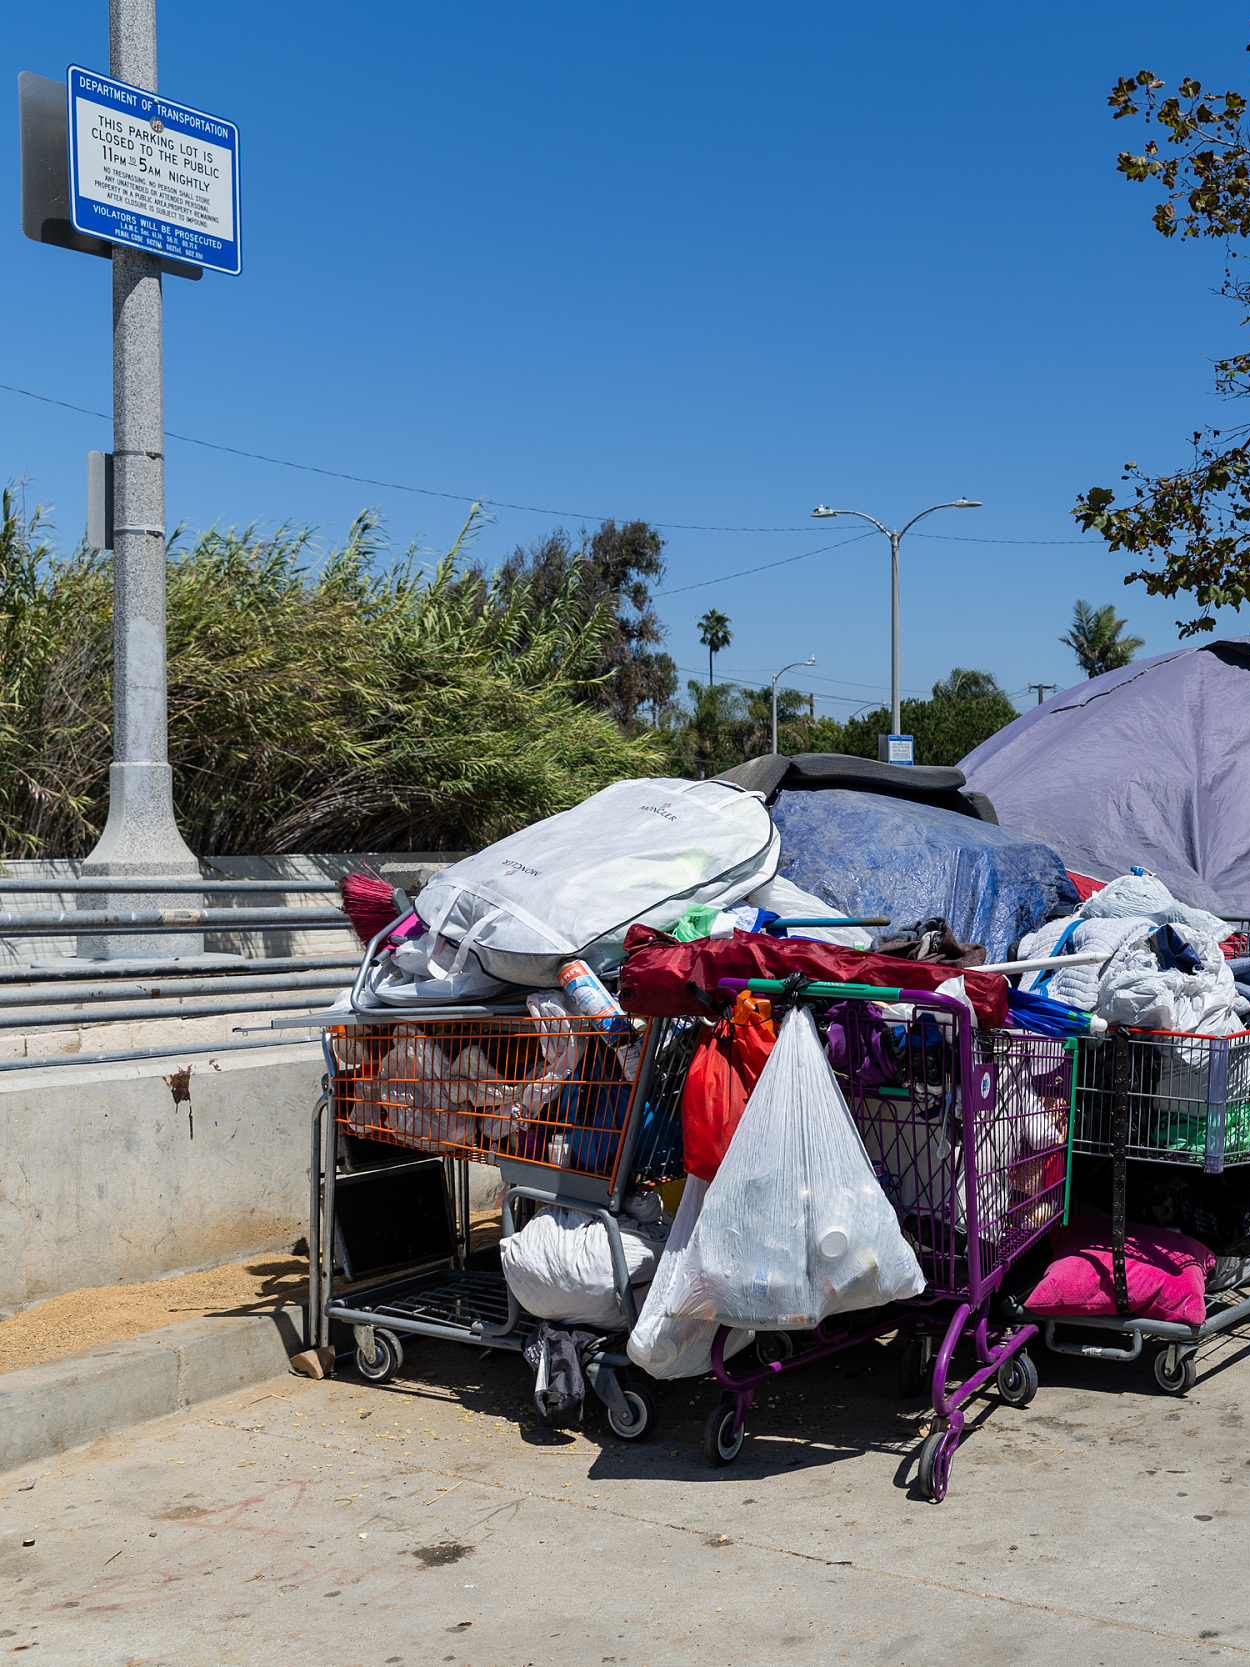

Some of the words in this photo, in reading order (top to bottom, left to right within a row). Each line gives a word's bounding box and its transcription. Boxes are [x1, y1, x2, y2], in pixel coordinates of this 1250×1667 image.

[80, 76, 137, 106] DEPARTMENT
[141, 99, 153, 111] OF
[157, 104, 228, 139] TRANSPORTATION
[91, 128, 134, 150] CLOSED
[140, 143, 153, 156] TO
[159, 150, 178, 165] THE
[184, 158, 219, 178] PUBLIC
[98, 115, 123, 133] THIS
[129, 126, 174, 150] PARKING
[180, 143, 198, 158] LOT
[204, 151, 213, 163] IS
[103, 166, 111, 174] NO
[158, 183, 177, 194] PERSON
[179, 190, 194, 200] SHALL
[195, 195, 210, 205] STORE
[129, 156, 137, 164] TO
[169, 170, 210, 192] NIGHTLY
[95, 180, 121, 193] PROPERTY
[135, 193, 152, 203] PUBLIC
[194, 211, 219, 223] REMAINING
[105, 175, 115, 183] ANY
[117, 179, 149, 194] UNATTENDED
[160, 192, 183, 204] ATTENDED
[185, 200, 209, 213] PERSONAL
[107, 192, 123, 202] AFTER
[125, 198, 147, 210] CLOSURE
[156, 207, 176, 219] SUBJECT
[93, 204, 137, 224] VIOLATORS
[140, 219, 158, 231] WILL
[161, 225, 171, 235] BE
[174, 229, 222, 249] PROSECUTED
[115, 229, 130, 239] PENAL
[131, 234, 143, 243] CODE
[638, 805, 677, 821] MONCLER
[502, 859, 542, 876] MONCLER
